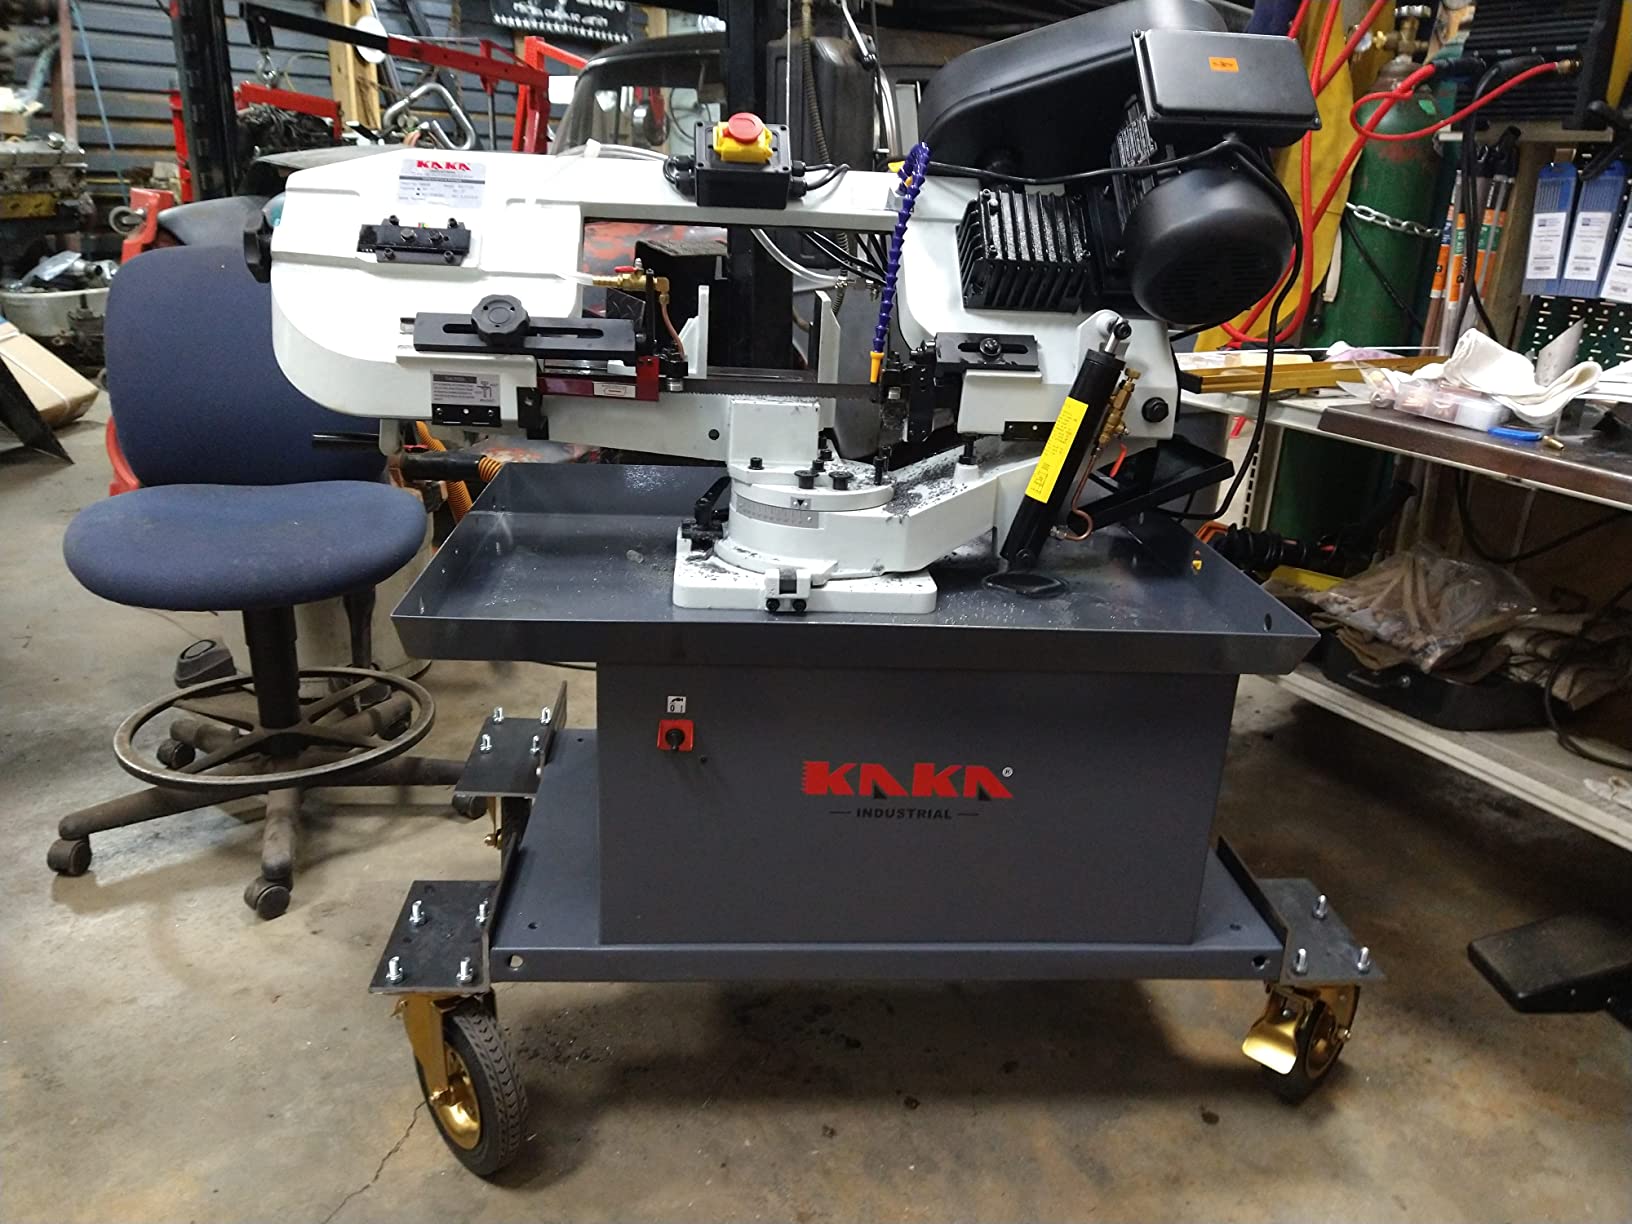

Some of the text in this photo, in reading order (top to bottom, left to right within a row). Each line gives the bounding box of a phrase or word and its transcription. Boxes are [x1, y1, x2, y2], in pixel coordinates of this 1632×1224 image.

[416, 160, 471, 172] KAKA
[801, 761, 1013, 801] KAKA
[856, 807, 952, 820] INDUSTRIAL
